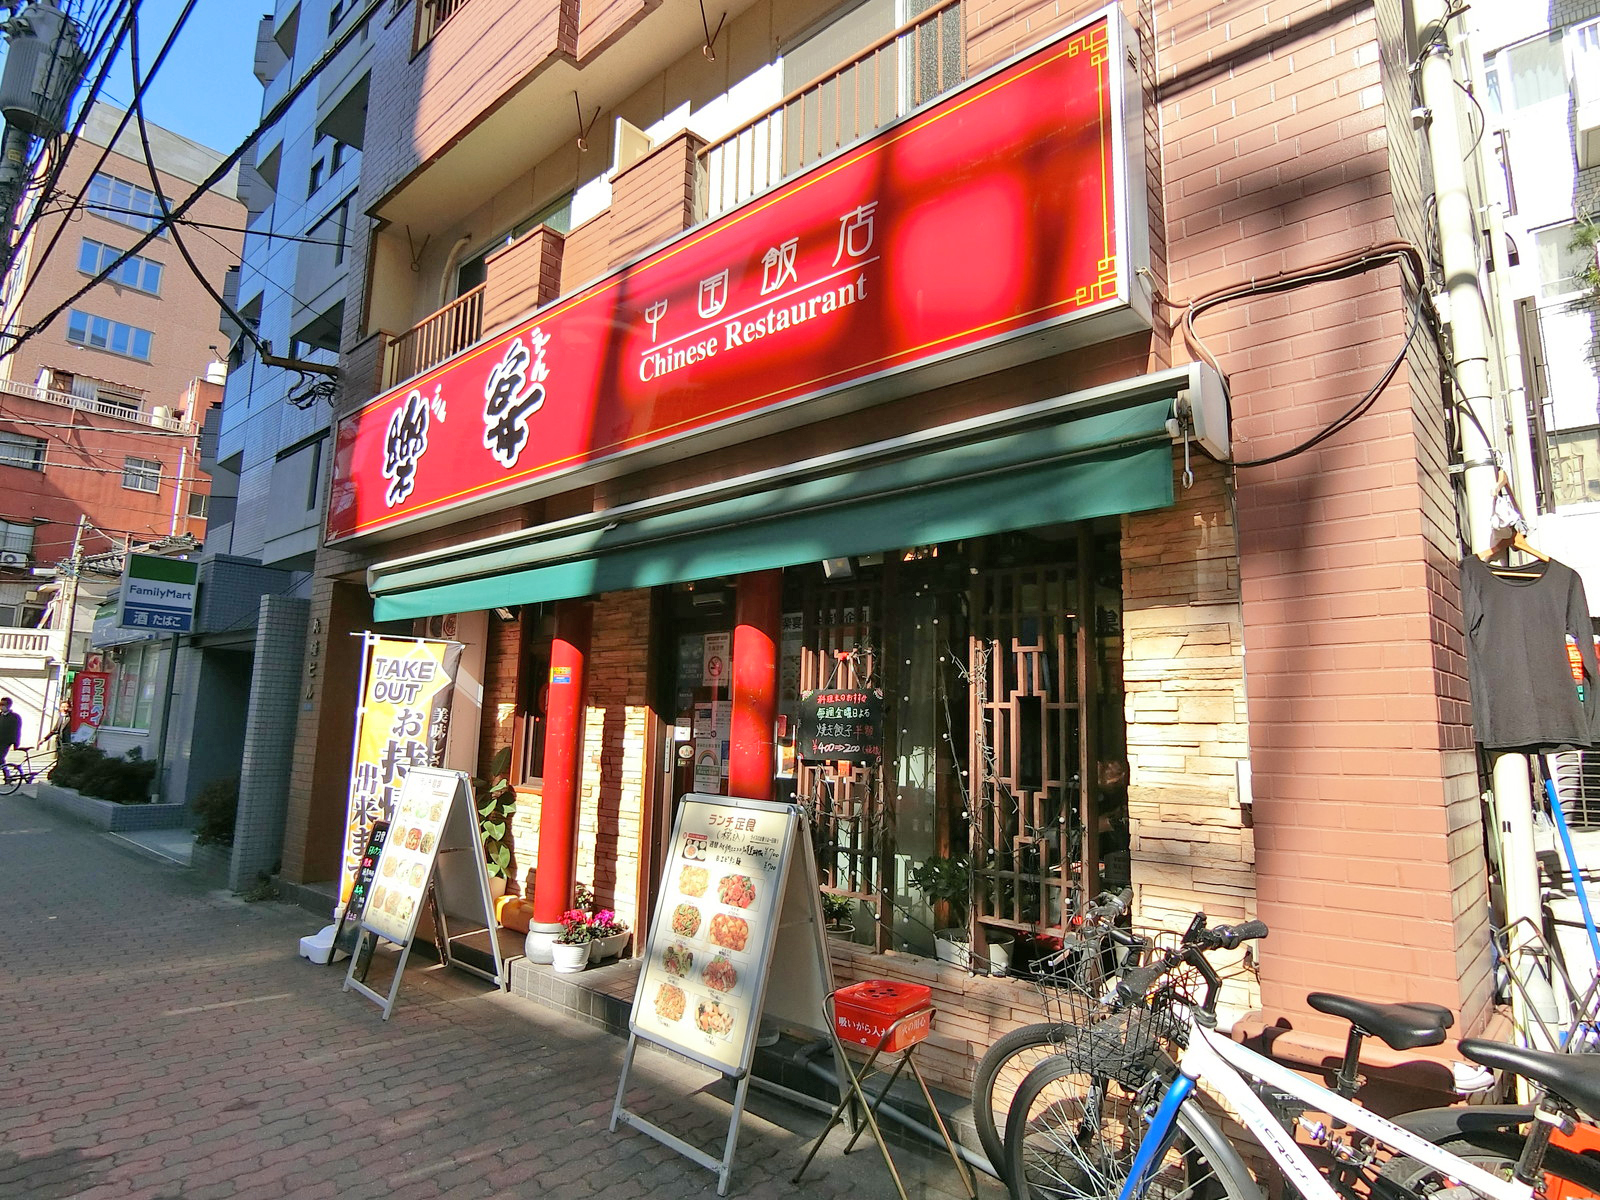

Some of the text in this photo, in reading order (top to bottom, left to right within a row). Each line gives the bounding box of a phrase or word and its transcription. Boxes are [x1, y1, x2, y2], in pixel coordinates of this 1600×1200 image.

[644, 201, 879, 342] 中国飯店
[638, 272, 868, 383] Chinese Restaurant
[129, 584, 192, 600] FamilyMart
[133, 611, 181, 627] 酒 たばこ
[375, 657, 435, 680] TAKE
[374, 681, 420, 702] OUT
[708, 814, 757, 832] ランチ定食
